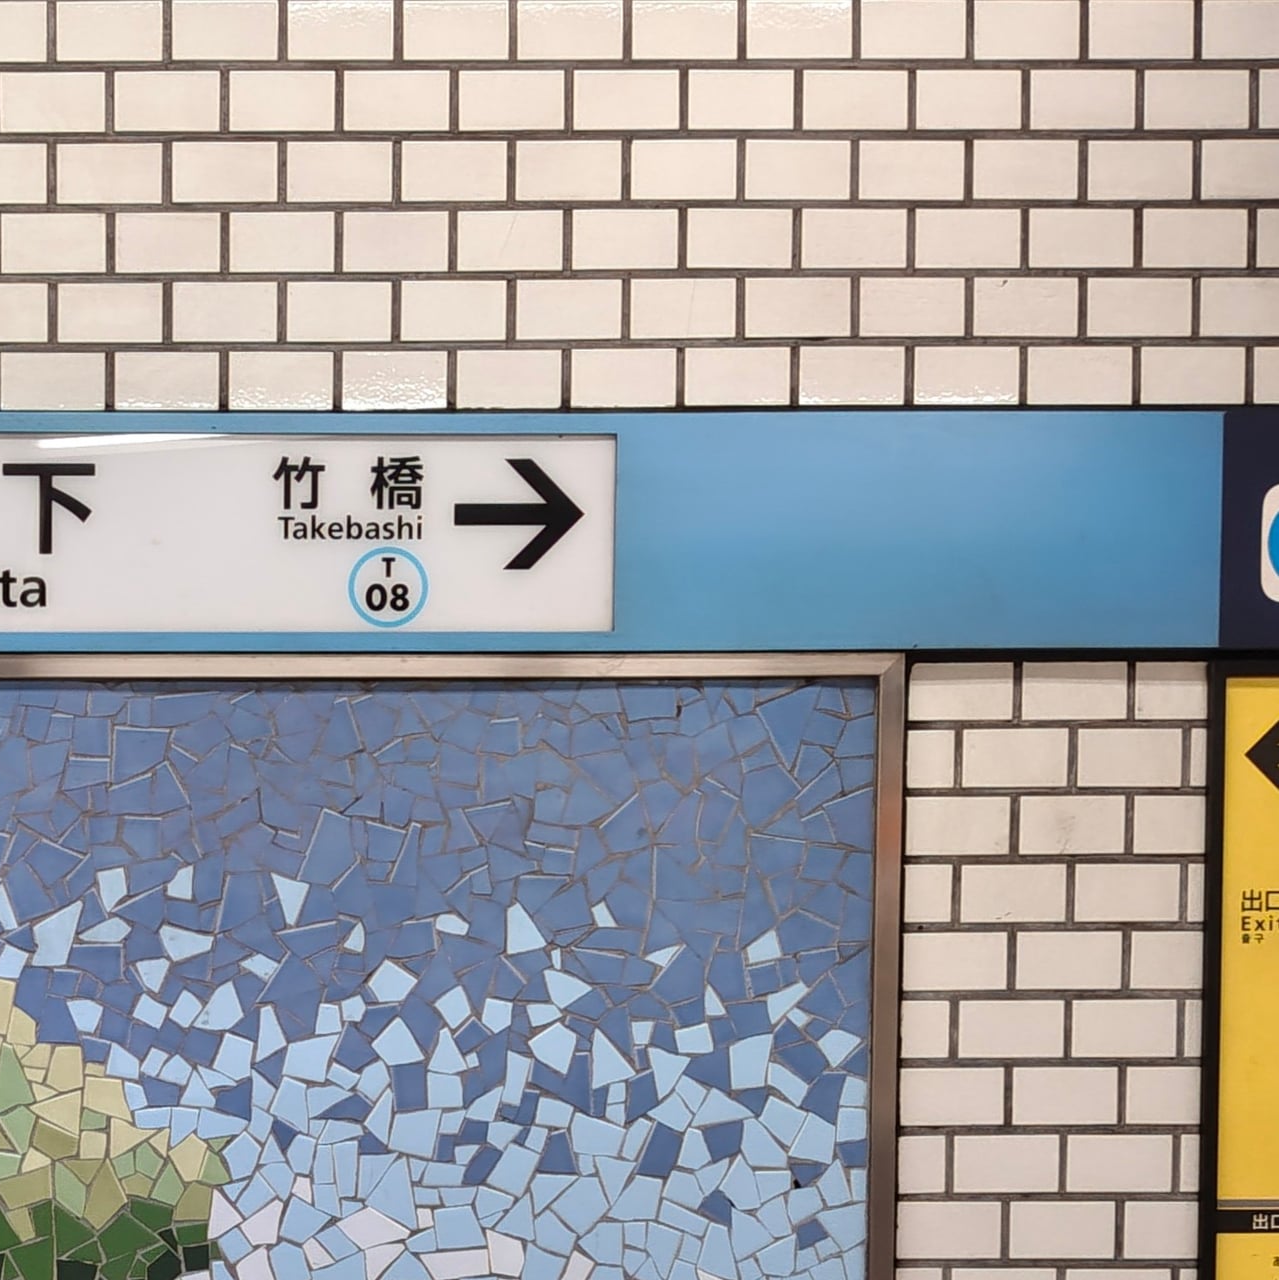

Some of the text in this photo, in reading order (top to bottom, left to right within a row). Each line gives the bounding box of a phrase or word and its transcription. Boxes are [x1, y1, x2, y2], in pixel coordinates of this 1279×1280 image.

[272, 456, 424, 510] 竹橋
[278, 515, 423, 541] Takebashi
[381, 557, 396, 578] T
[365, 584, 410, 611] 08
